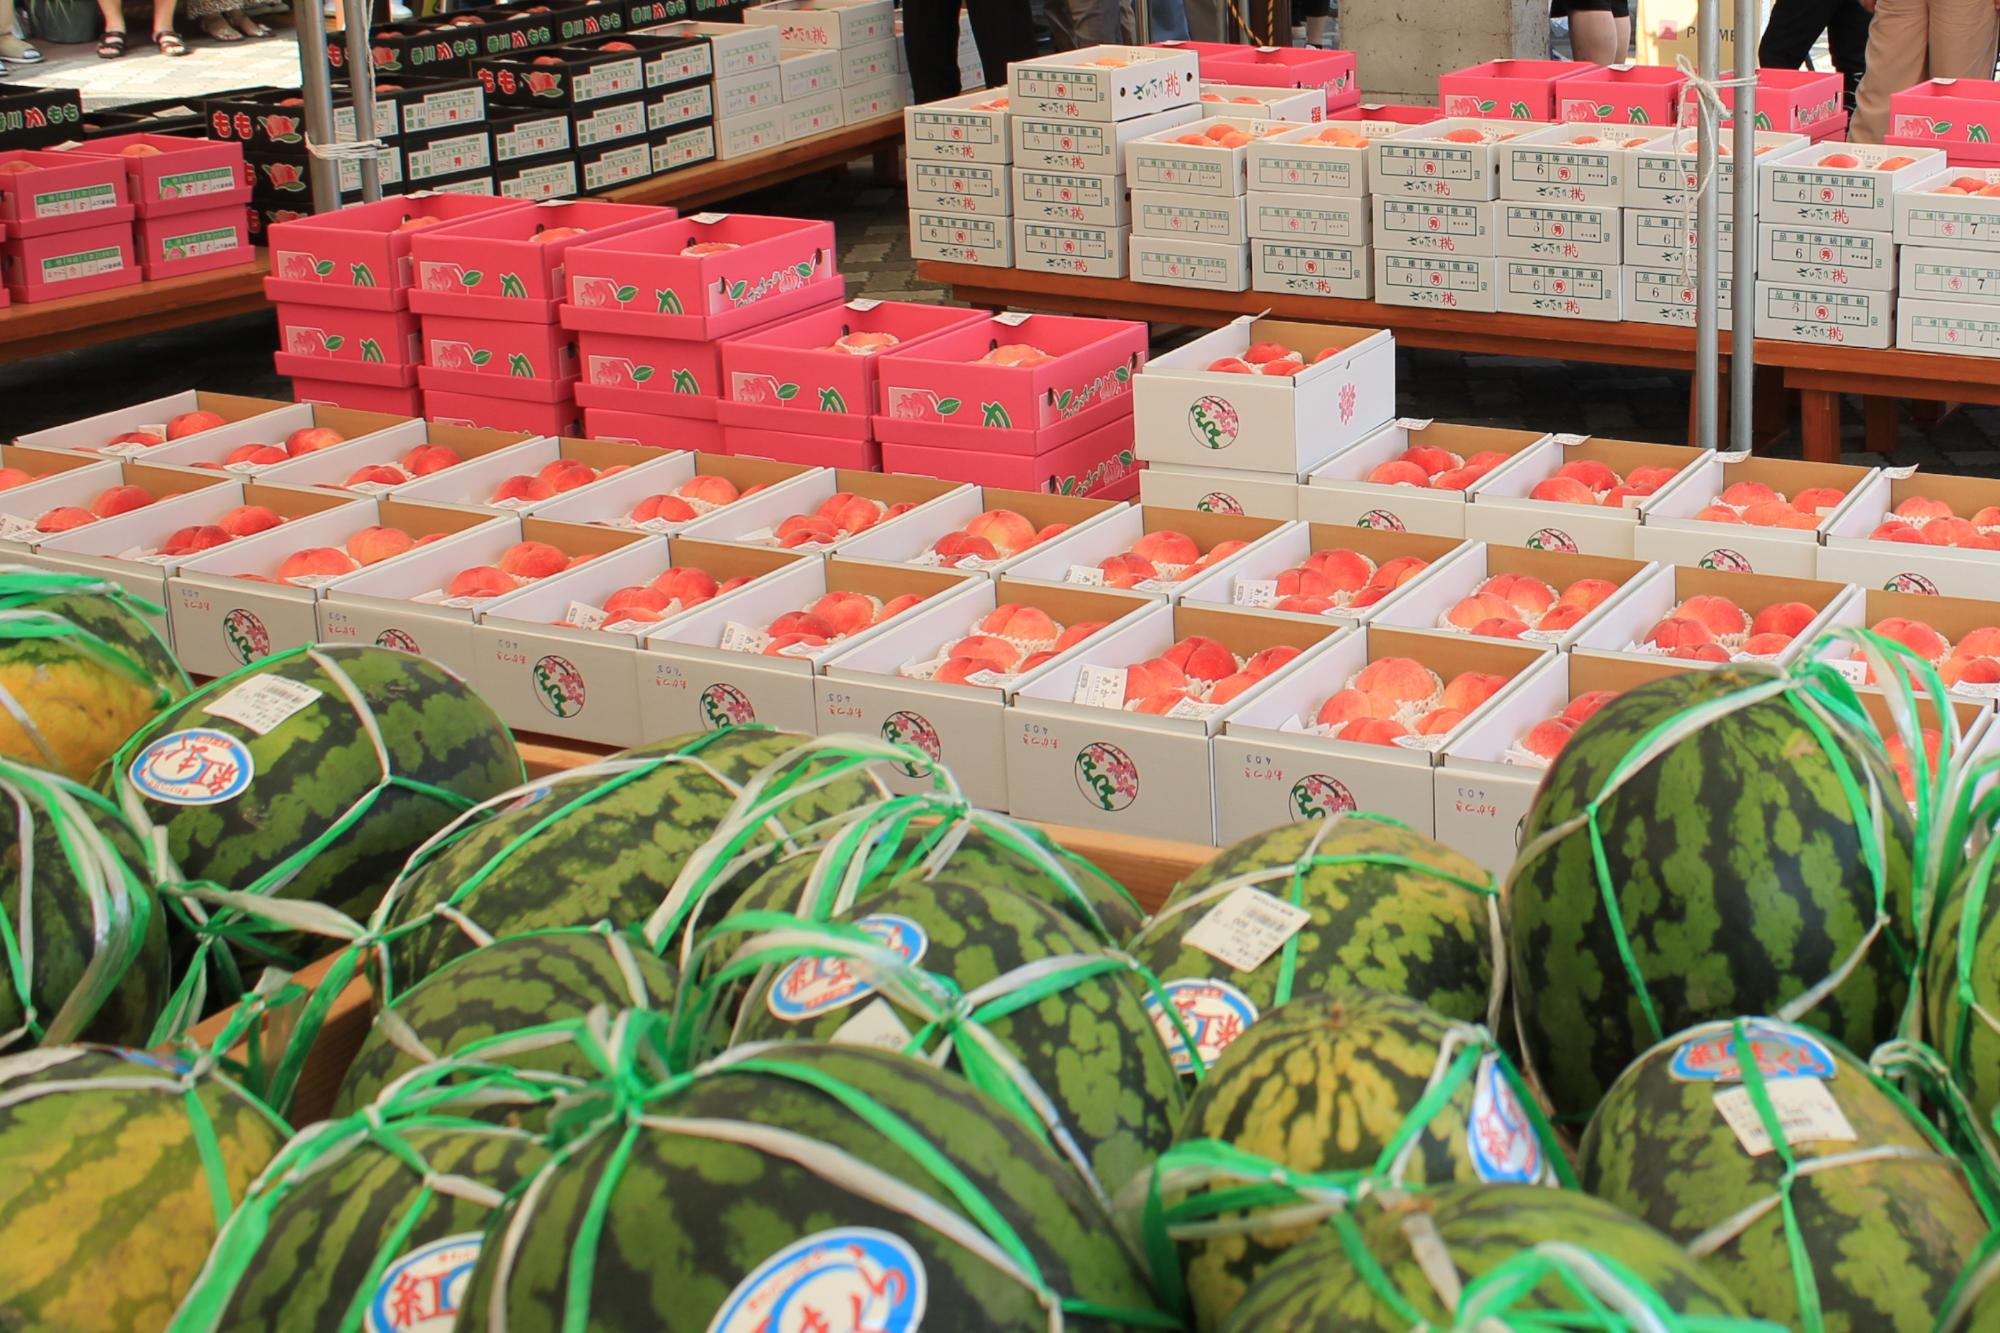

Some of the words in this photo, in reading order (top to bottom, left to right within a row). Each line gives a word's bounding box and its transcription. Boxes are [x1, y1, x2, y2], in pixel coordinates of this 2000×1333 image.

[600, 13, 621, 30] もも
[527, 27, 550, 44] もも
[453, 39, 477, 56] もも
[477, 68, 517, 95] もも
[47, 103, 79, 124] もも
[213, 111, 253, 139] もも
[1537, 165, 1543, 175] 6
[1313, 173, 1319, 182] 7
[1659, 172, 1666, 183] 6
[1799, 189, 1806, 200] 6
[1312, 221, 1318, 231] 7
[1970, 224, 1977, 234] 7
[1664, 235, 1670, 245] 6
[1796, 249, 1802, 259] 6
[1278, 261, 1284, 271] 6
[1190, 267, 1196, 277] 7
[1406, 273, 1413, 283] 6
[1533, 280, 1540, 290] 6
[1977, 279, 1985, 290] 7
[1653, 287, 1659, 297] 6
[828, 694, 850, 702] 403
[1024, 723, 1048, 735] 403
[1023, 734, 1058, 749] あかつき
[1246, 755, 1271, 765] 403
[140, 736, 240, 795] 紅まくら
[1244, 768, 1282, 781] あかつき
[1458, 788, 1485, 798] 403
[1455, 801, 1496, 816] あかつき
